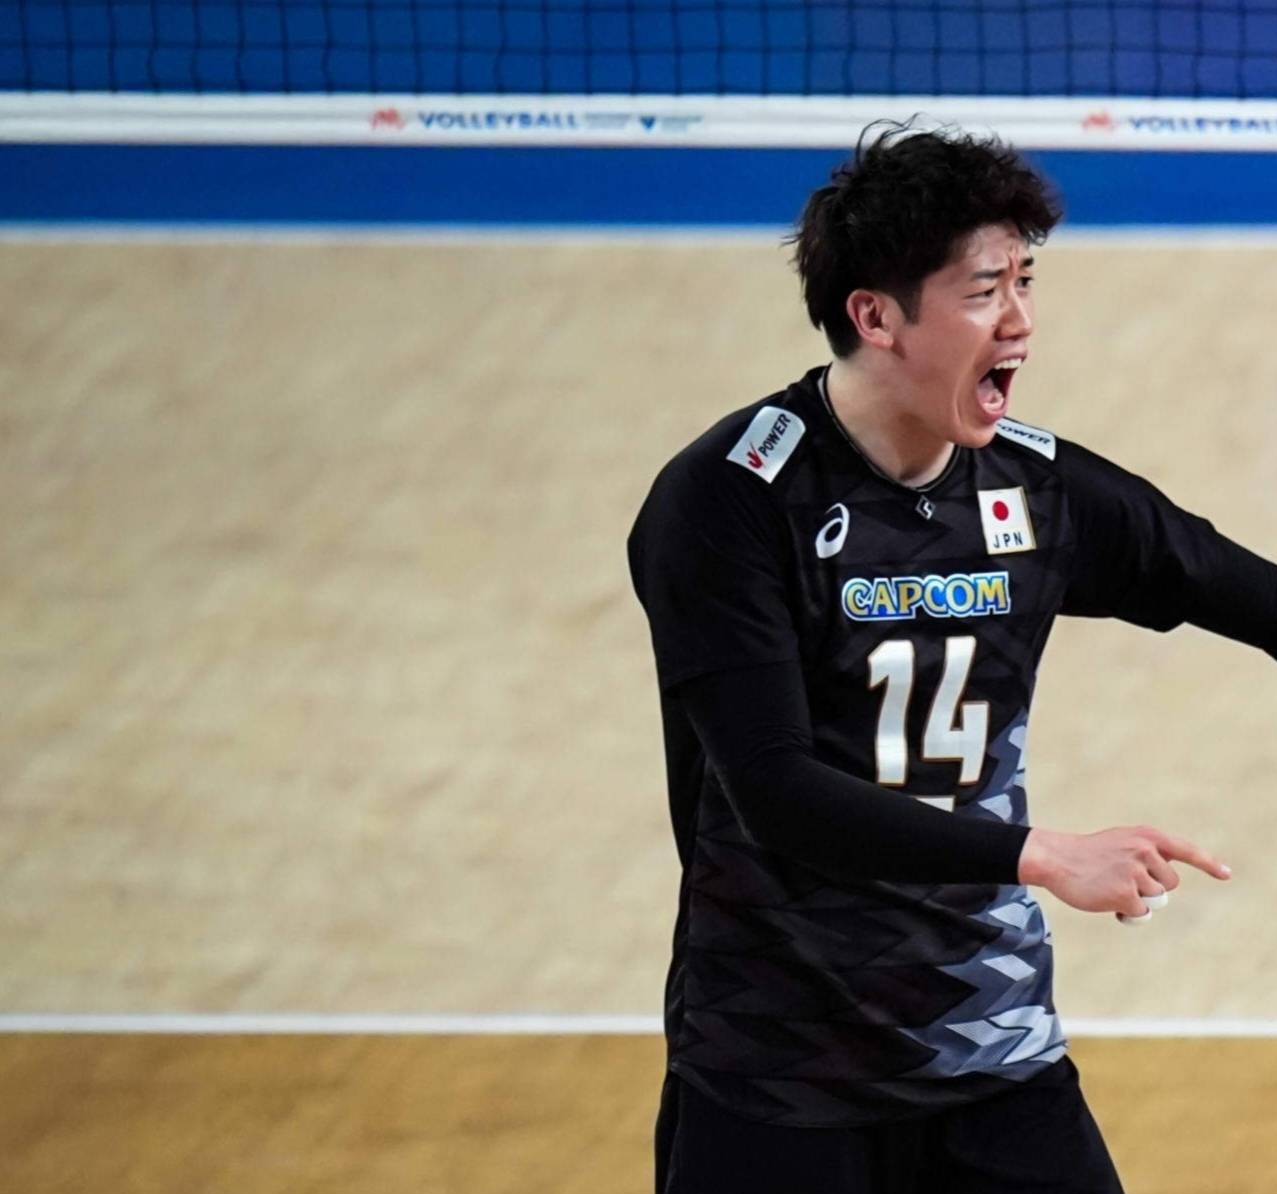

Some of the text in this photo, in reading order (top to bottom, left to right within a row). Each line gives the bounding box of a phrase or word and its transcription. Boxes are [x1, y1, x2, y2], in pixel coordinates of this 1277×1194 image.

[417, 111, 580, 129] VOLLEYBALL
[758, 413, 791, 457] POWER
[993, 531, 1024, 550] JPN
[842, 571, 1011, 622] CAPCOM
[867, 635, 990, 785] 14
